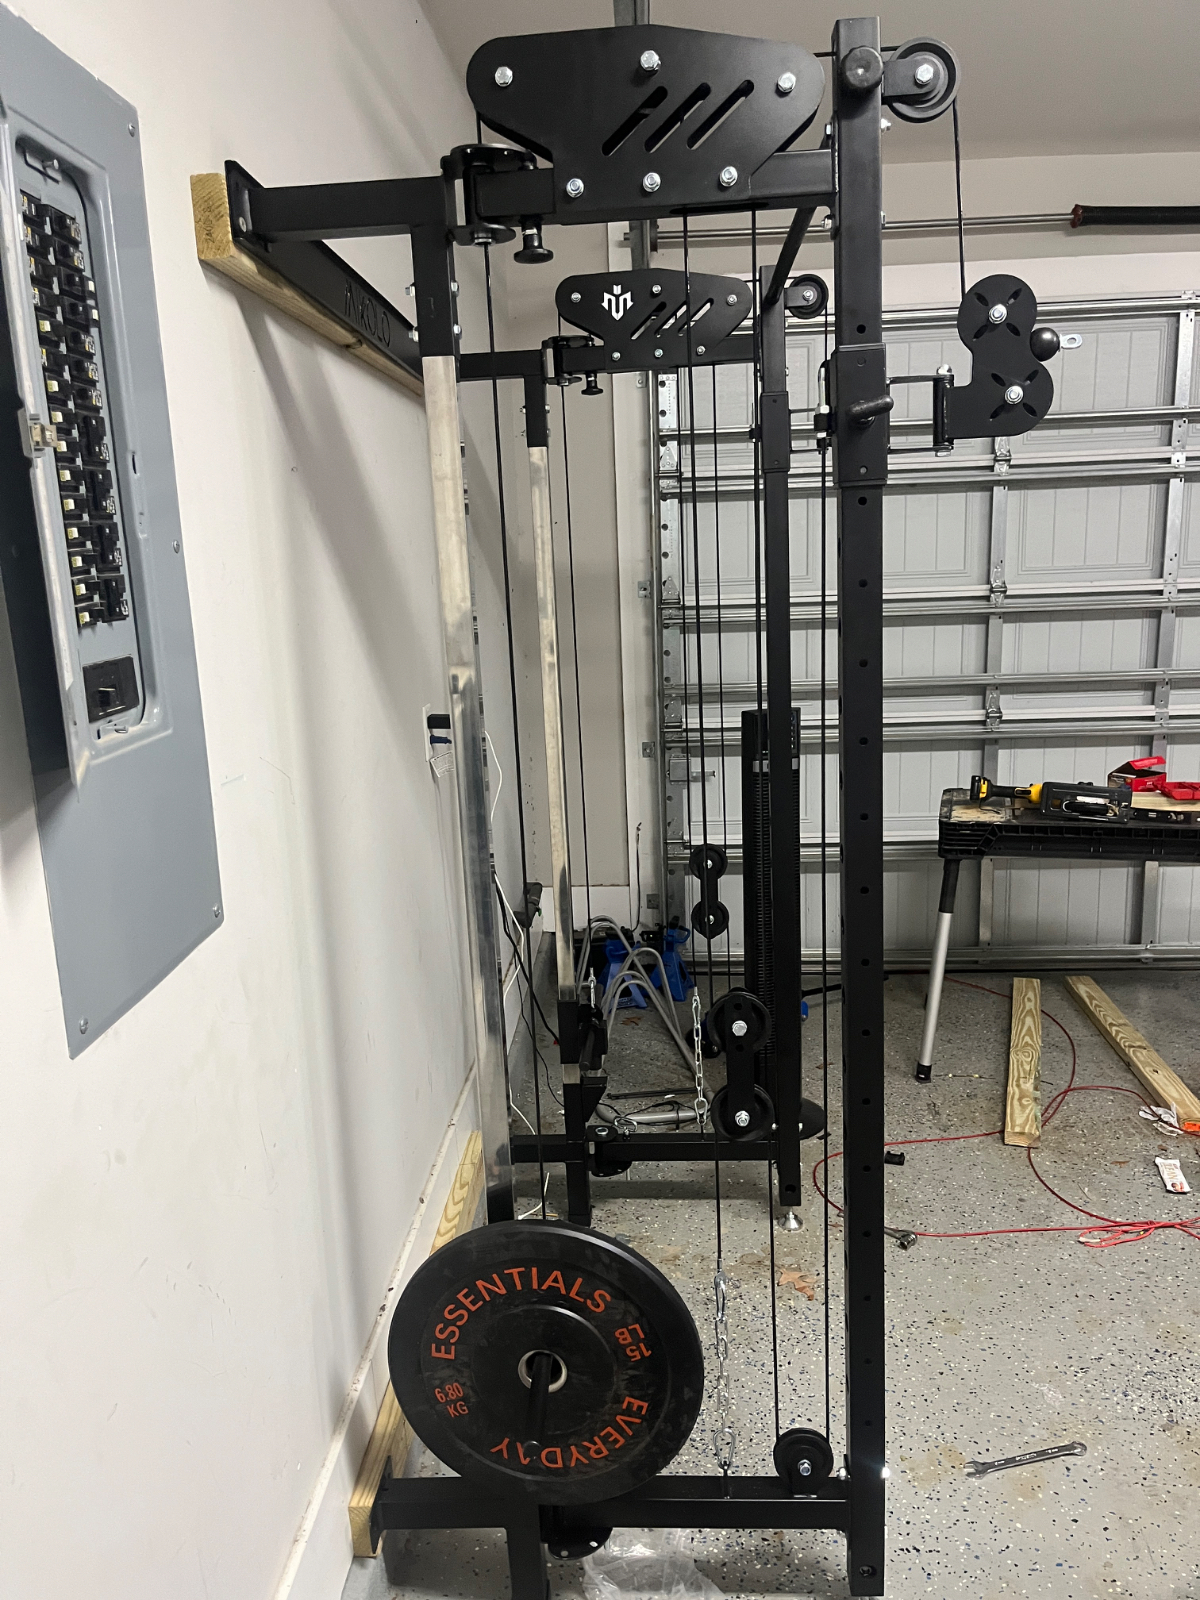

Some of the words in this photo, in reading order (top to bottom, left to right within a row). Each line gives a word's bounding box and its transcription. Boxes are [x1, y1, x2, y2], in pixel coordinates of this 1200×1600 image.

[431, 1266, 612, 1360] ESSENTIALS
[614, 1323, 645, 1345] LB
[625, 1342, 652, 1362] 15
[434, 1382, 464, 1403] 6.80
[446, 1401, 469, 1418] KG
